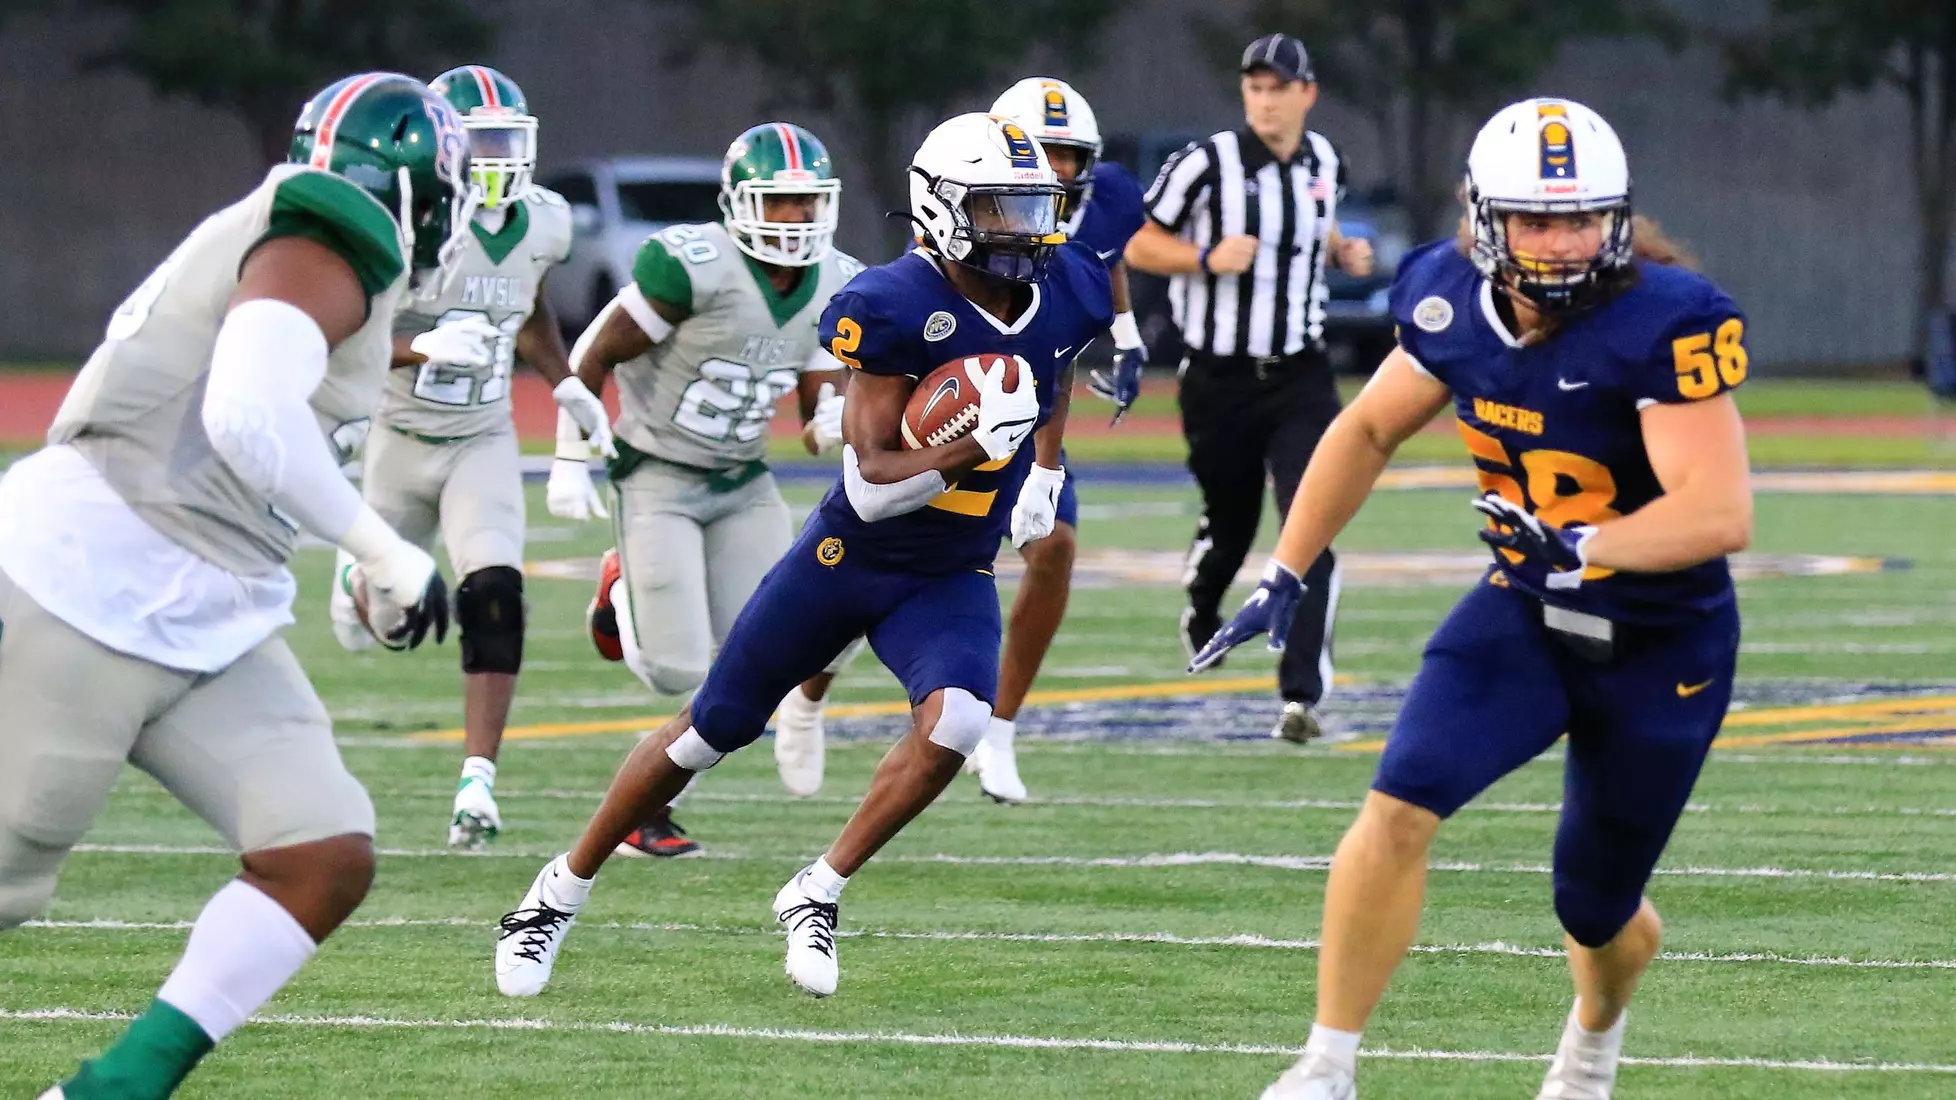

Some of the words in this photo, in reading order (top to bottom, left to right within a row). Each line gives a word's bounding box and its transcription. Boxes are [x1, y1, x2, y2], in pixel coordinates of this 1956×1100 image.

[661, 225, 719, 264] 20
[462, 276, 522, 306] MVSU
[832, 317, 863, 369] 2
[1673, 318, 1748, 399] 58
[1473, 397, 1544, 436] RACERS
